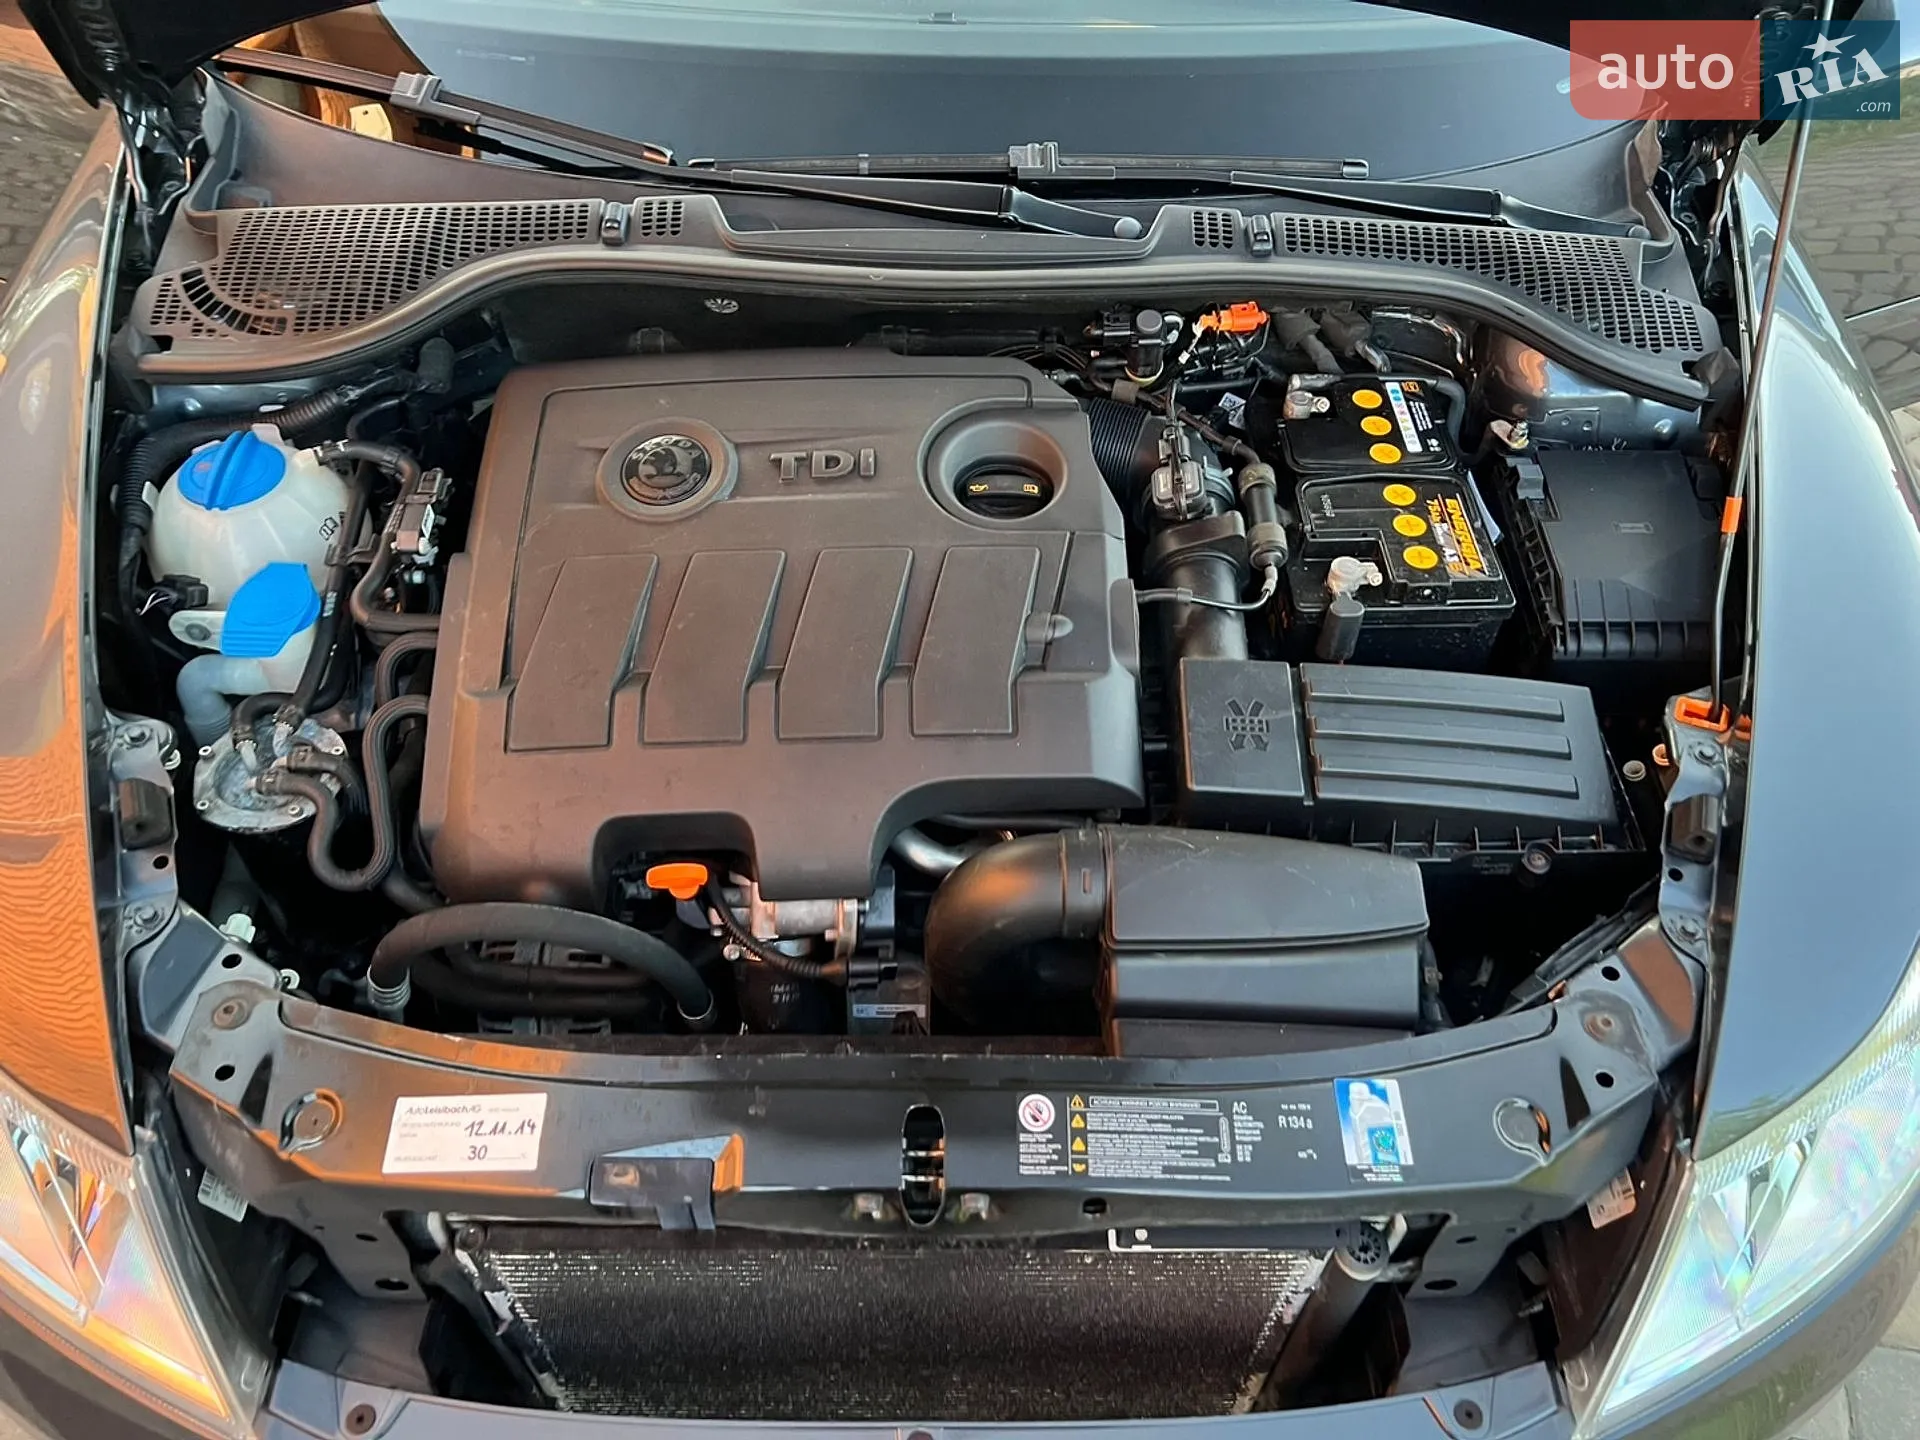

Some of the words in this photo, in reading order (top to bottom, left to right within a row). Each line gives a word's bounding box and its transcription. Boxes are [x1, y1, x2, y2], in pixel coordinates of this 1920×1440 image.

[768, 446, 877, 484] TDI
[1232, 1101, 1247, 1114] AC
[467, 1145, 488, 1161] 30
